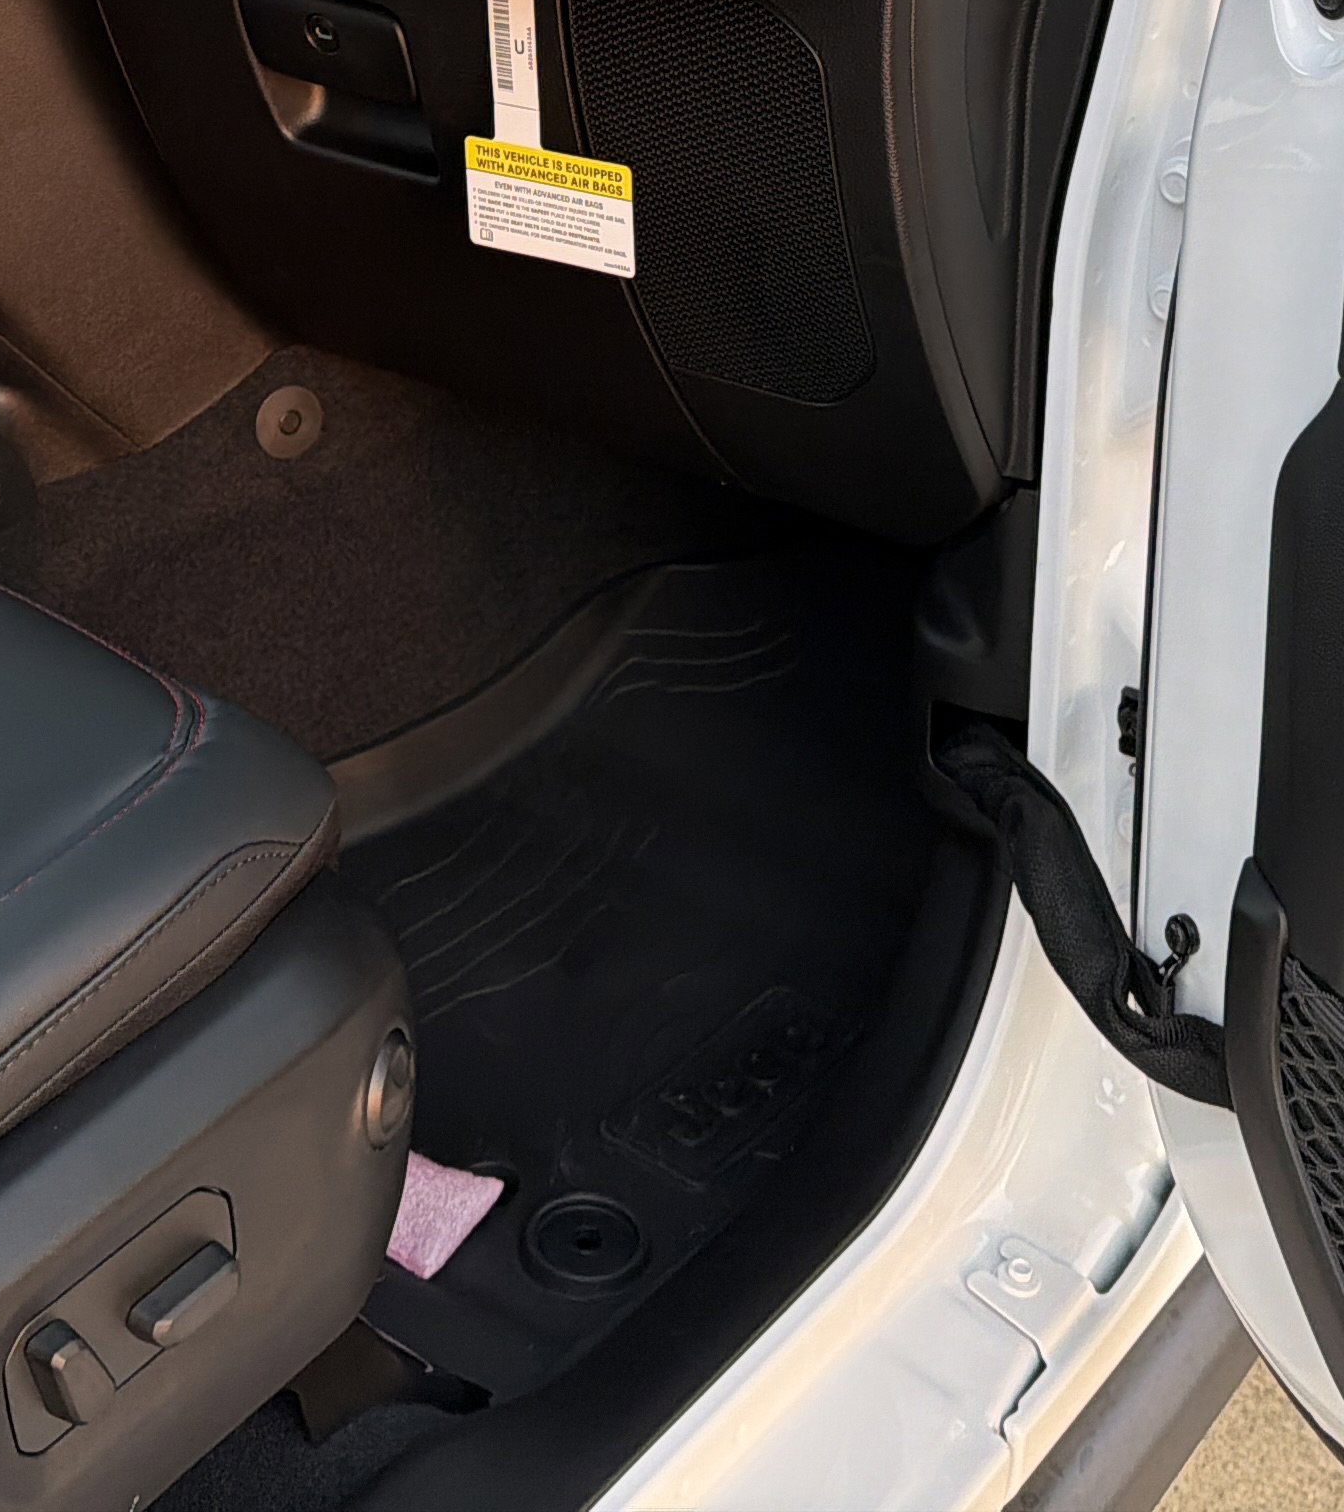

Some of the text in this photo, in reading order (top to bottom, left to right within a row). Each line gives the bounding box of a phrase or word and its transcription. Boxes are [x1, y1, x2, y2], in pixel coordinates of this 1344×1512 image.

[514, 39, 524, 55] U
[476, 144, 623, 183] THIS VEHICLE IS EQUIPPED
[476, 158, 623, 196] WITH ADVANCED AIR BAGS
